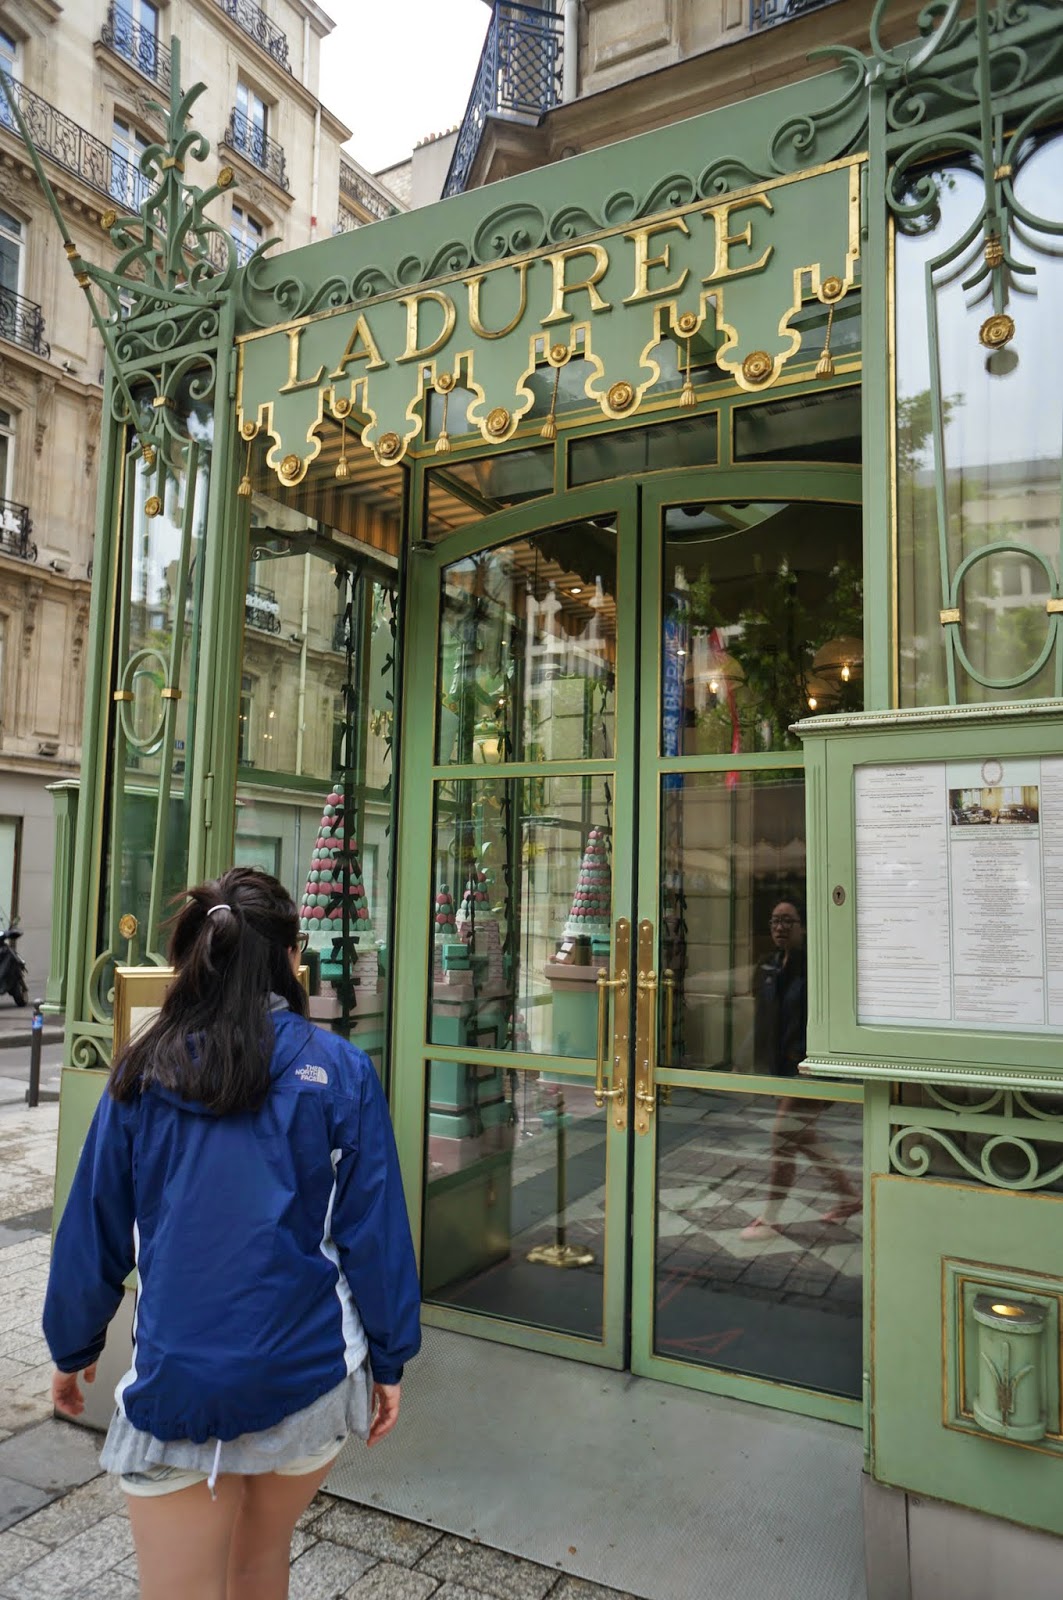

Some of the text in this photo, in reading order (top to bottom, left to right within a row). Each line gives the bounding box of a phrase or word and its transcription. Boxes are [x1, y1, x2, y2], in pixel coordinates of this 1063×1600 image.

[278, 193, 774, 395] LADUREE
[295, 1068, 318, 1078] NORTH
[300, 1074, 318, 1082] FACE
